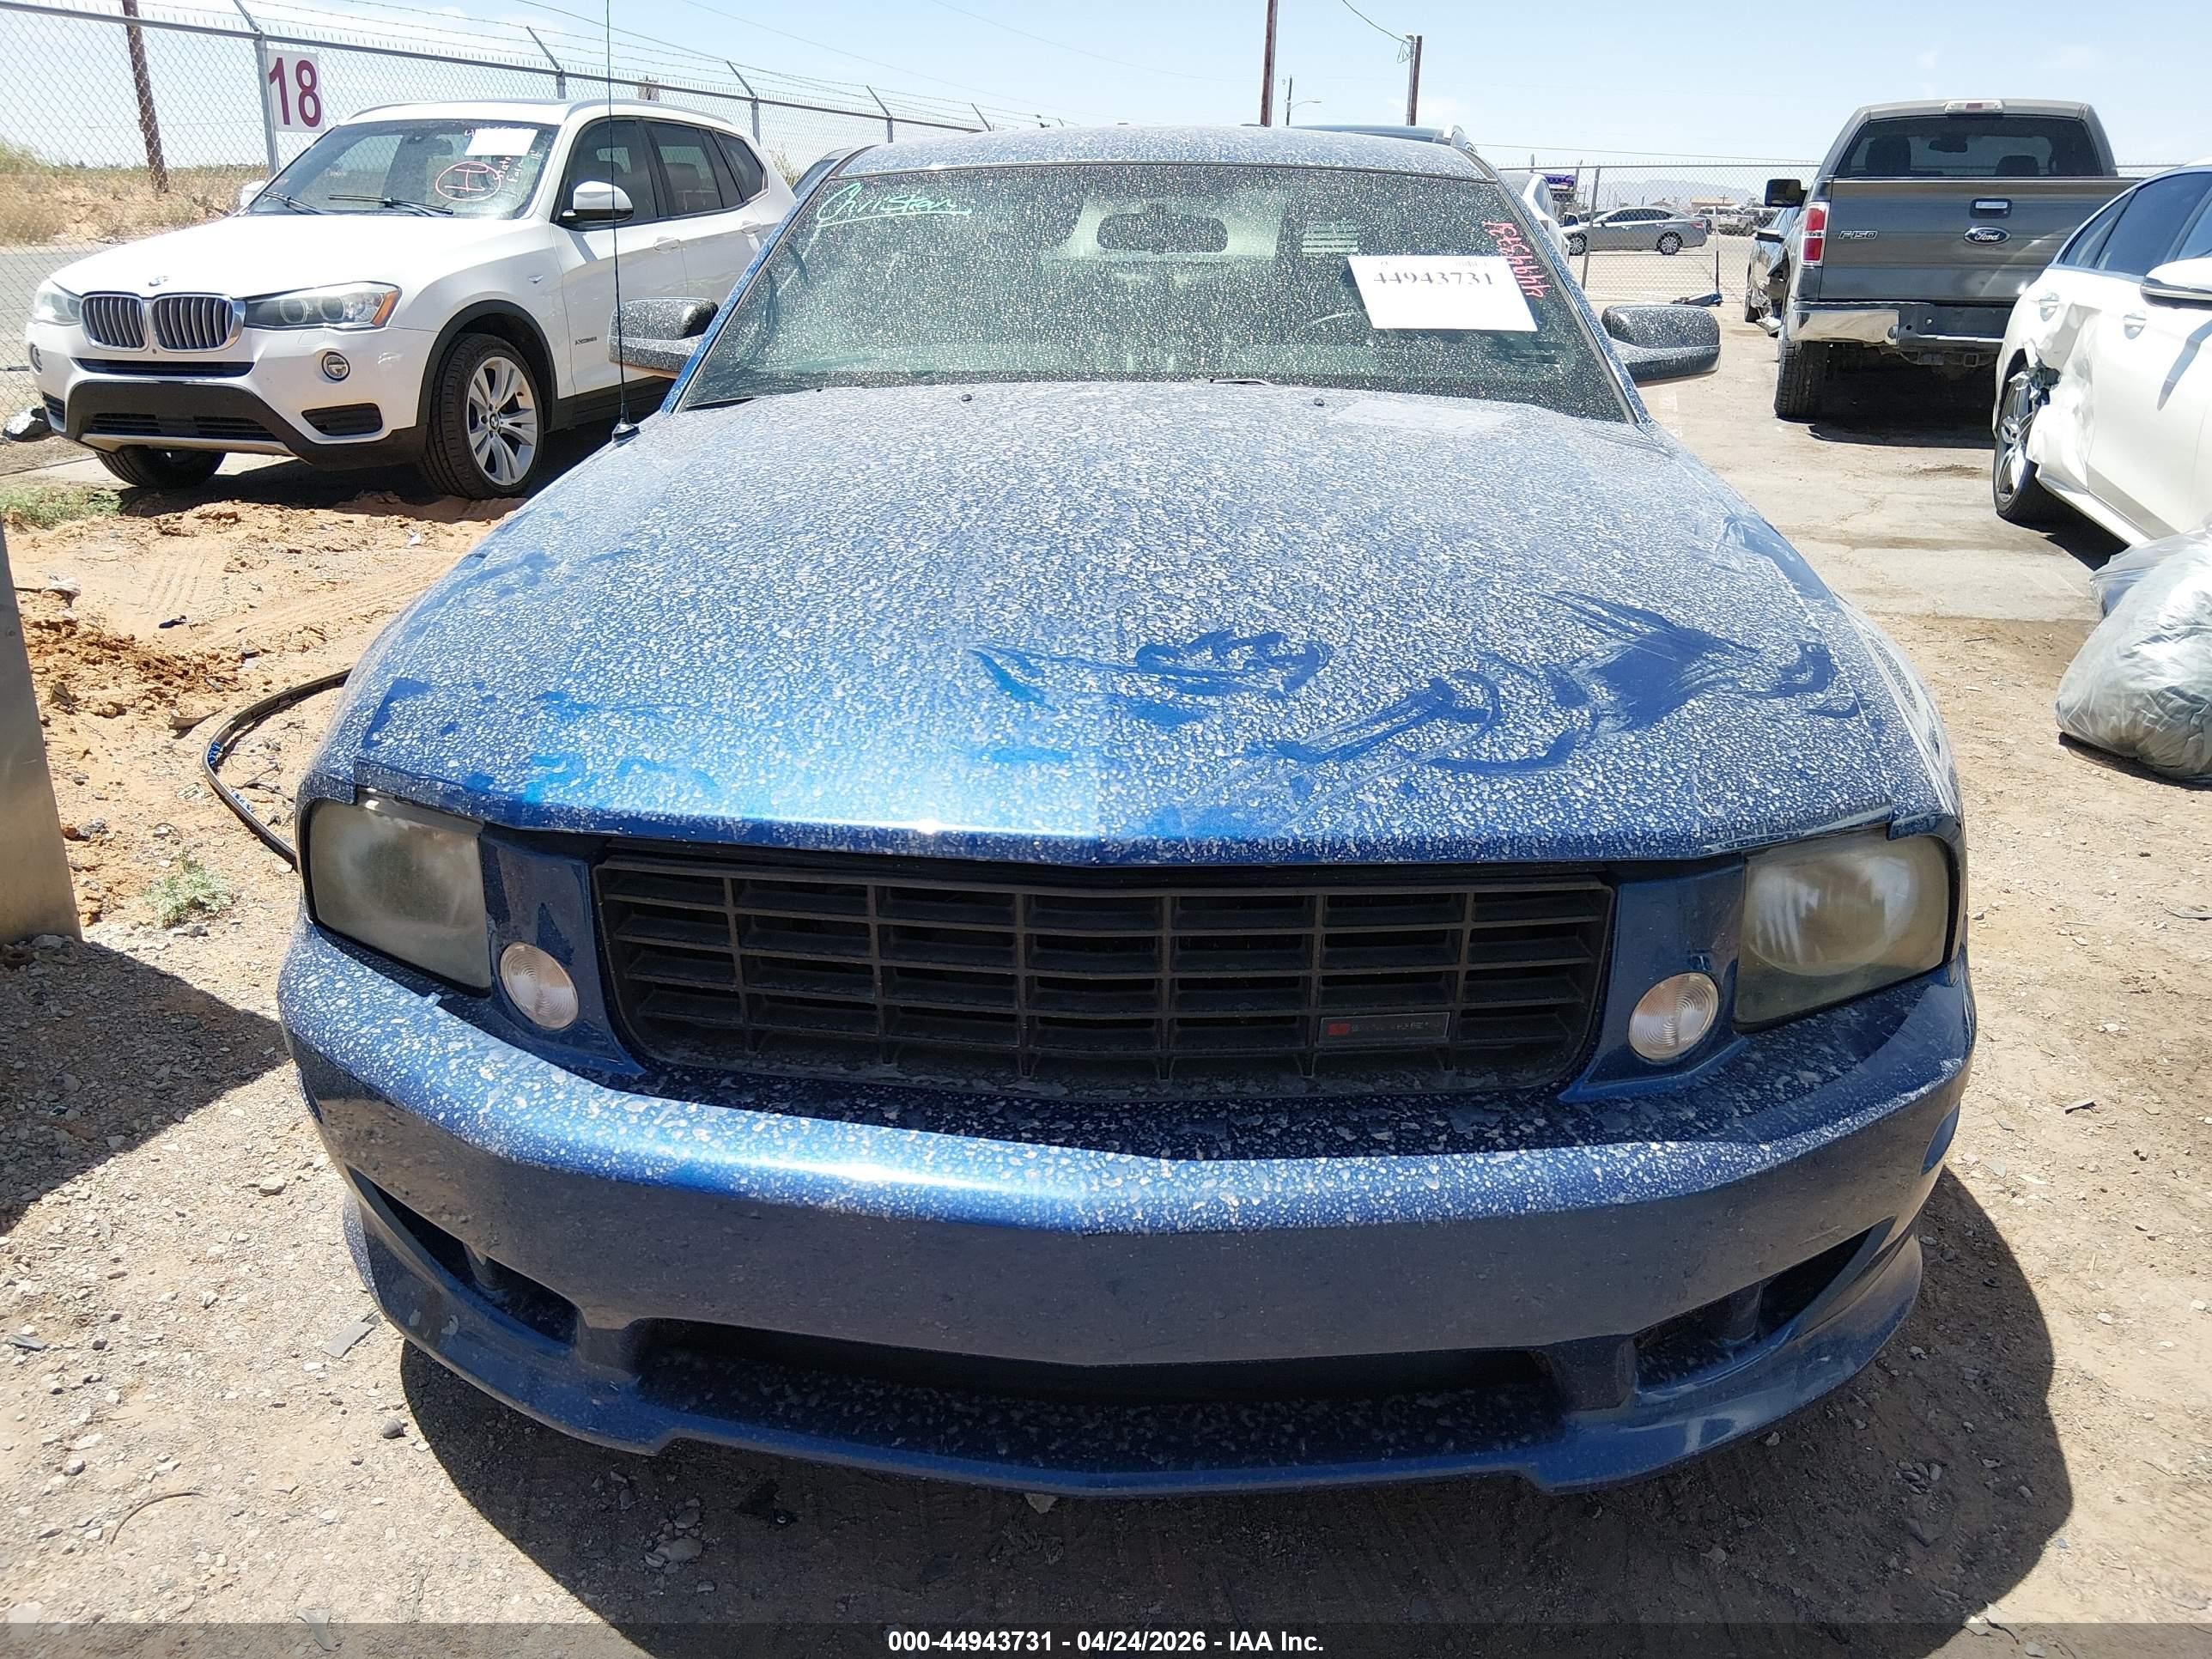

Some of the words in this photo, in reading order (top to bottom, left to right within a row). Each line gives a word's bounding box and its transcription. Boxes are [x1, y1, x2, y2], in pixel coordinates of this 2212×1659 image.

[268, 57, 322, 128] 18
[1974, 230, 2000, 241] Ford
[1374, 270, 1494, 286] 44943731
